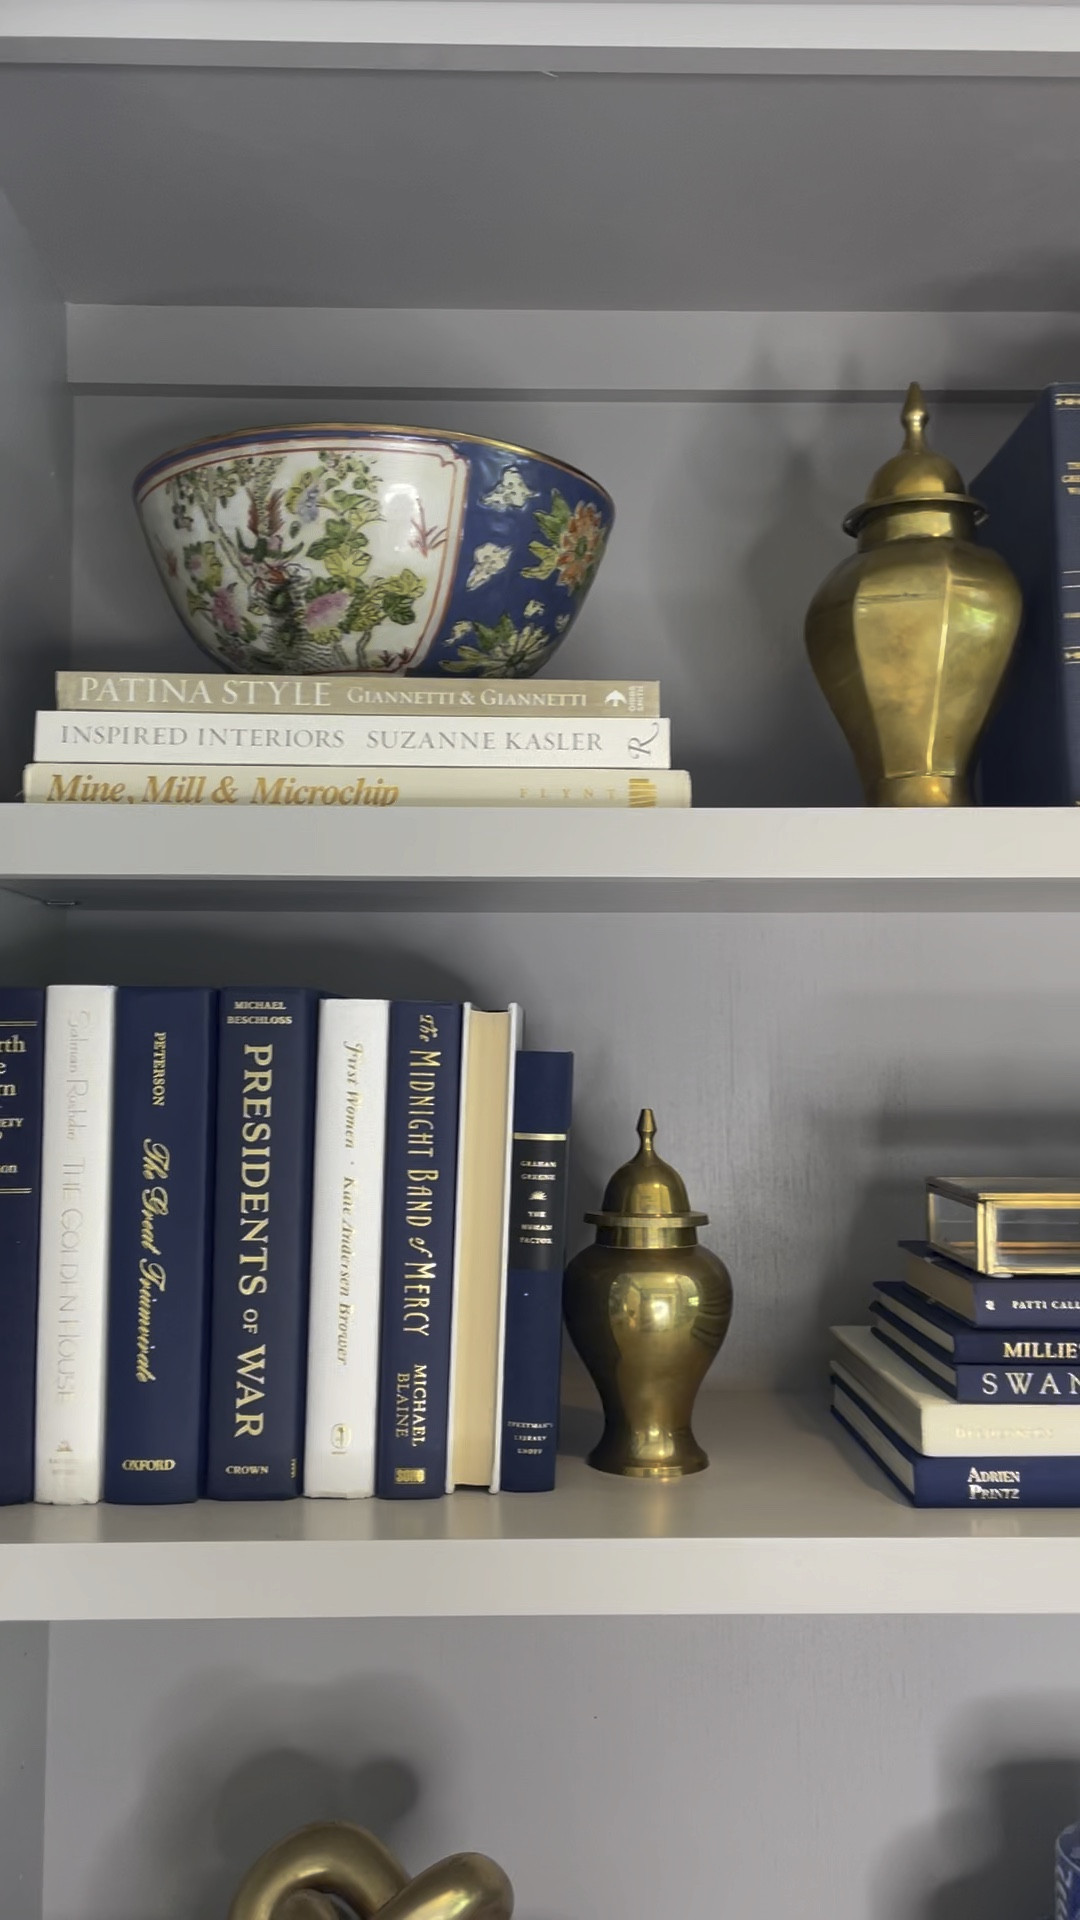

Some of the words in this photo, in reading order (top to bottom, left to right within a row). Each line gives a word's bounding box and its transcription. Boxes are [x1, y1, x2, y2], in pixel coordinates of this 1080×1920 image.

[80, 677, 214, 704] PATINA
[221, 680, 332, 706] STYLE
[459, 689, 476, 705] &
[61, 725, 188, 746] INSPIRED
[198, 727, 345, 748] INTERIORS
[366, 730, 496, 750] SUZANNE
[506, 732, 603, 751] KASLER
[47, 774, 135, 804] Mine,
[141, 775, 207, 804] Mill
[211, 776, 239, 804] &
[250, 777, 399, 806] Microchip
[520, 787, 623, 800] FLYNT
[226, 1015, 293, 1025] BESCHLOSS
[234, 1001, 287, 1010] MICHAEL
[419, 1014, 439, 1043] The
[152, 1031, 167, 1107] PETERSON
[343, 1040, 364, 1086] First
[345, 1090, 361, 1149] Women
[407, 1050, 442, 1158] MIDNIGHT
[62, 1157, 85, 1201] THE
[142, 1138, 170, 1180] The
[238, 1043, 274, 1296] PRESIDENTS
[342, 1176, 355, 1215] Kate
[405, 1169, 440, 1227] BAND
[141, 1186, 169, 1256] Great
[339, 1218, 354, 1297] Andersen
[408, 1237, 433, 1259] of
[135, 1258, 167, 1383] Triumvirate
[402, 1262, 437, 1337] MERCY
[1012, 1300, 1048, 1310] PATTI
[242, 1308, 259, 1335] OF
[336, 1302, 352, 1366] Brower
[233, 1343, 267, 1439] WAR
[395, 1373, 411, 1438] BLAINE
[412, 1364, 428, 1447] MICHAEL
[121, 1459, 176, 1472] OXFORD
[225, 1465, 269, 1475] CROWN
[967, 1466, 1021, 1483] ADRIEN
[968, 1484, 1021, 1500] PRINTZ
